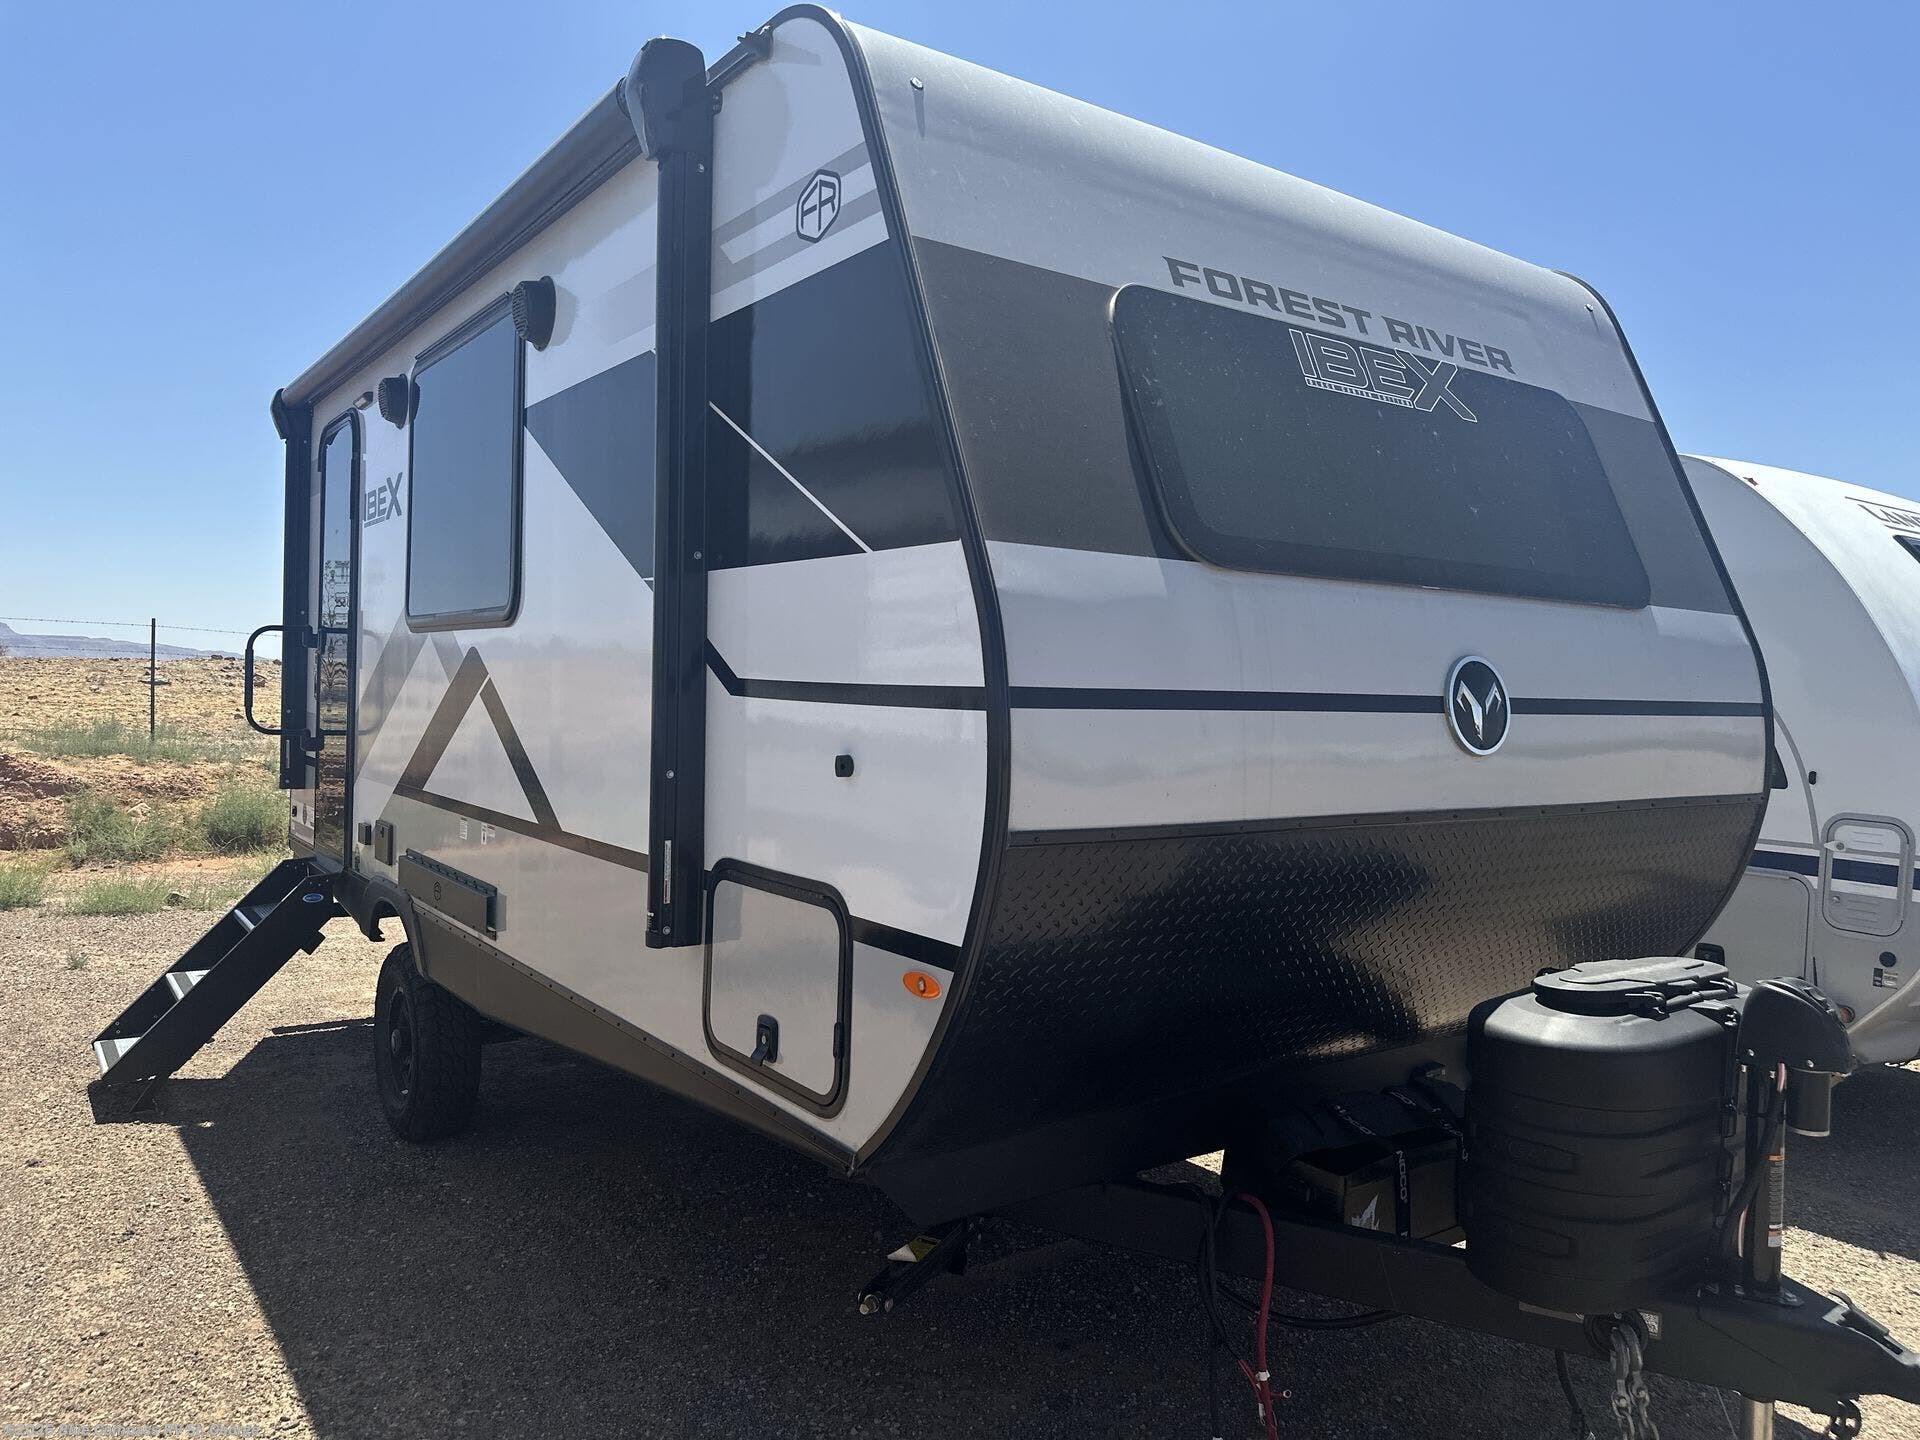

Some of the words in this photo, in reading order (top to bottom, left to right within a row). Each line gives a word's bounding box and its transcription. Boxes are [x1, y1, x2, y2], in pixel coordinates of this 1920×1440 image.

[1162, 256, 1372, 336] FOREST
[1381, 315, 1516, 375] RIVER
[1289, 328, 1477, 422] IBEX
